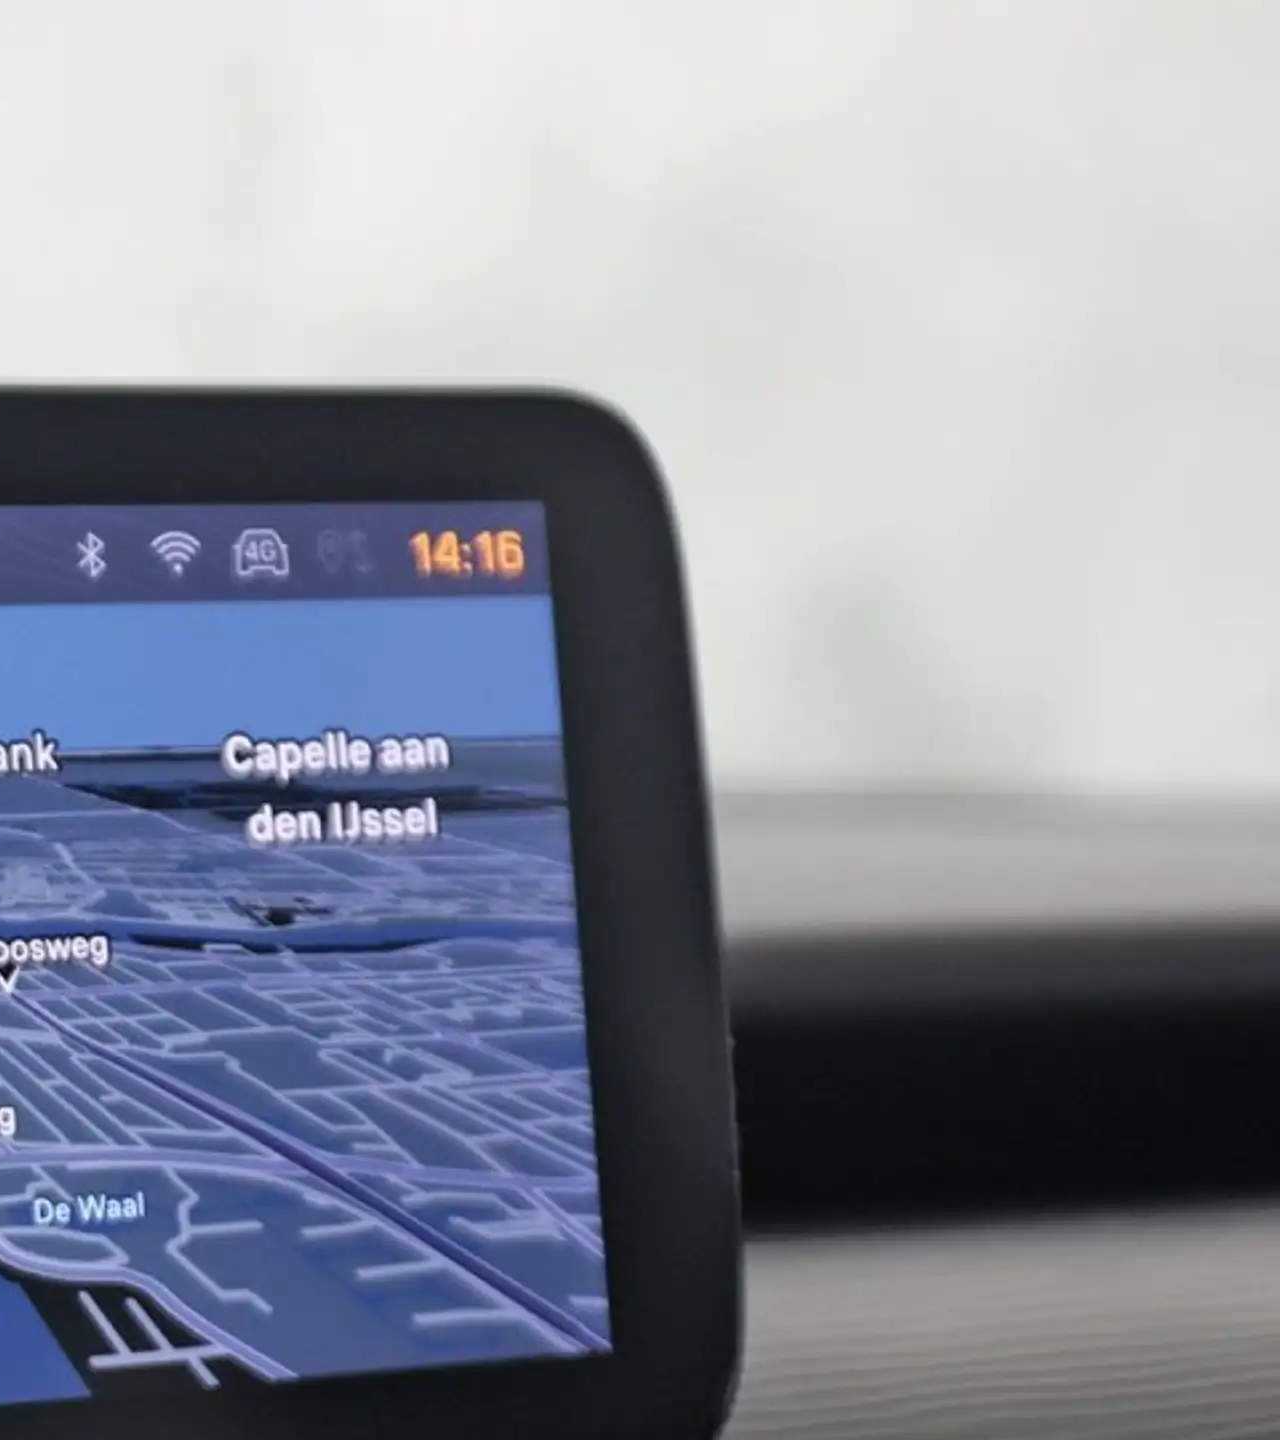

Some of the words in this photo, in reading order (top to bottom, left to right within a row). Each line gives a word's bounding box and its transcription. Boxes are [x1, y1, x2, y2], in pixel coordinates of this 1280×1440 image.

[243, 538, 279, 562] 4G
[409, 529, 526, 578] 14:16
[222, 731, 372, 785] Capelle
[377, 736, 449, 770] aan
[247, 803, 321, 846] den
[331, 798, 439, 843] IJssel
[32, 1197, 73, 1226] De
[77, 1191, 146, 1223] Waal
